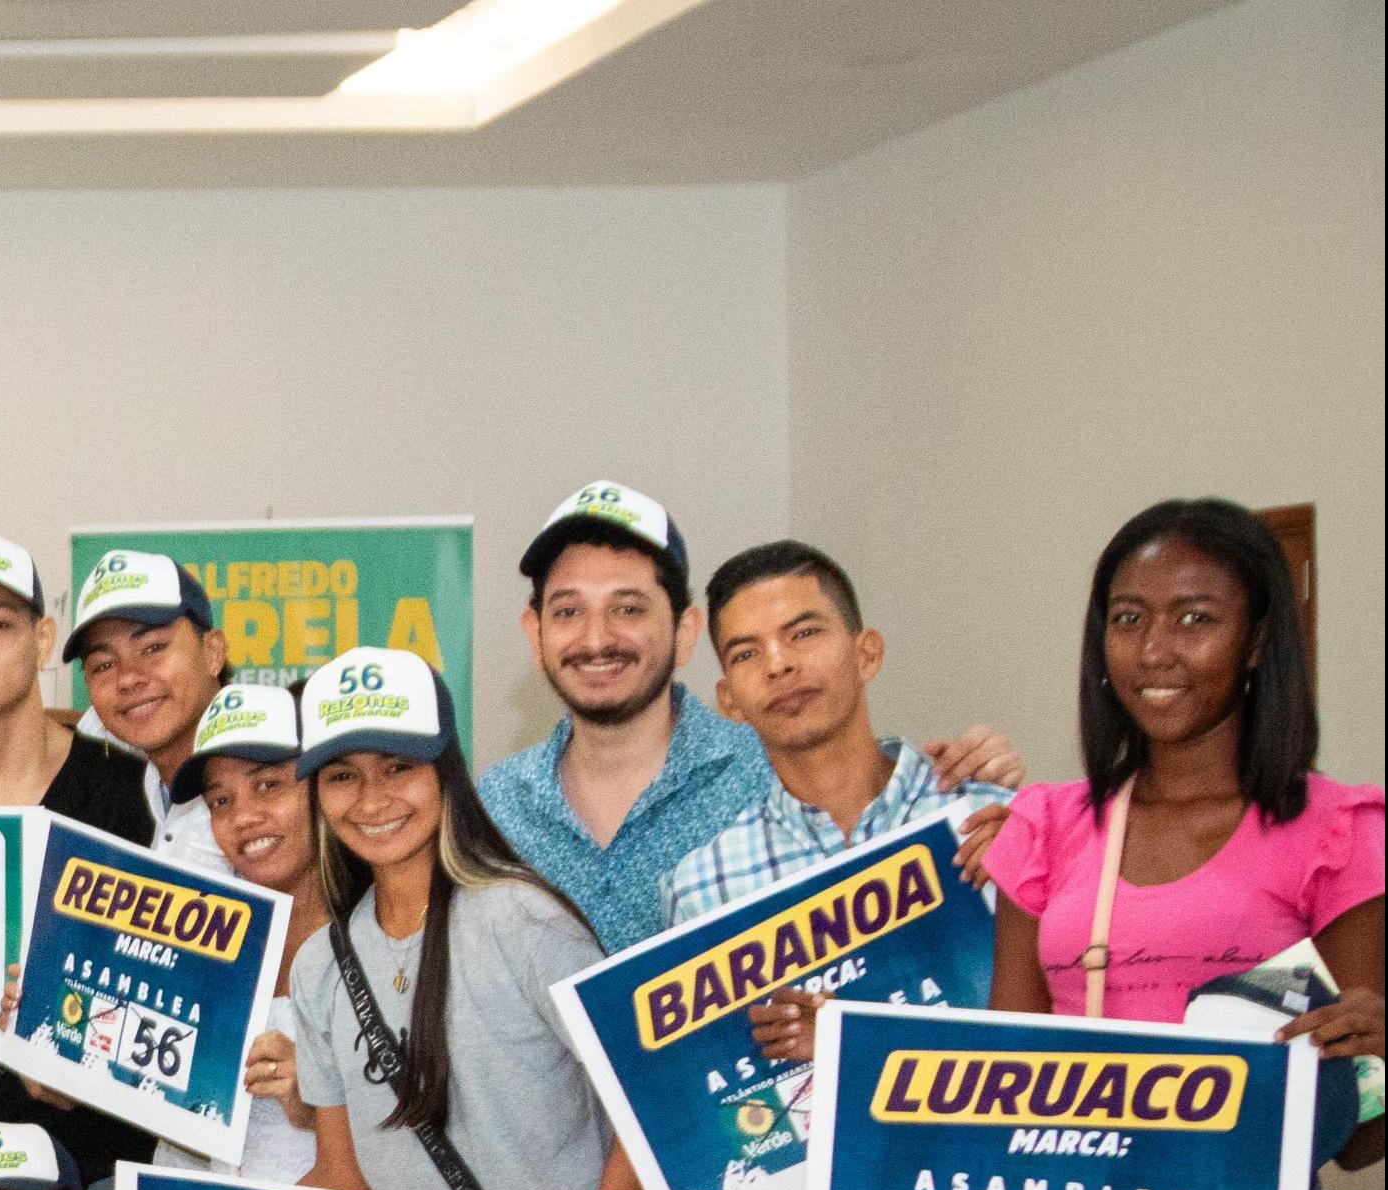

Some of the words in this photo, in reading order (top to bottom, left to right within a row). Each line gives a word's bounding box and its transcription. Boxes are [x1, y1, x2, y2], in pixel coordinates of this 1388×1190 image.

[339, 663, 384, 694] 56
[62, 866, 242, 951] REPELÓN
[114, 933, 178, 969] MARCA:
[648, 857, 936, 1041] BARANOA
[64, 953, 201, 1023] ASAMBLEA
[131, 1016, 182, 1077] 56
[885, 1058, 1233, 1122] LURUACO
[744, 1130, 793, 1155] Verde
[1008, 1128, 1132, 1157] MARCA:
